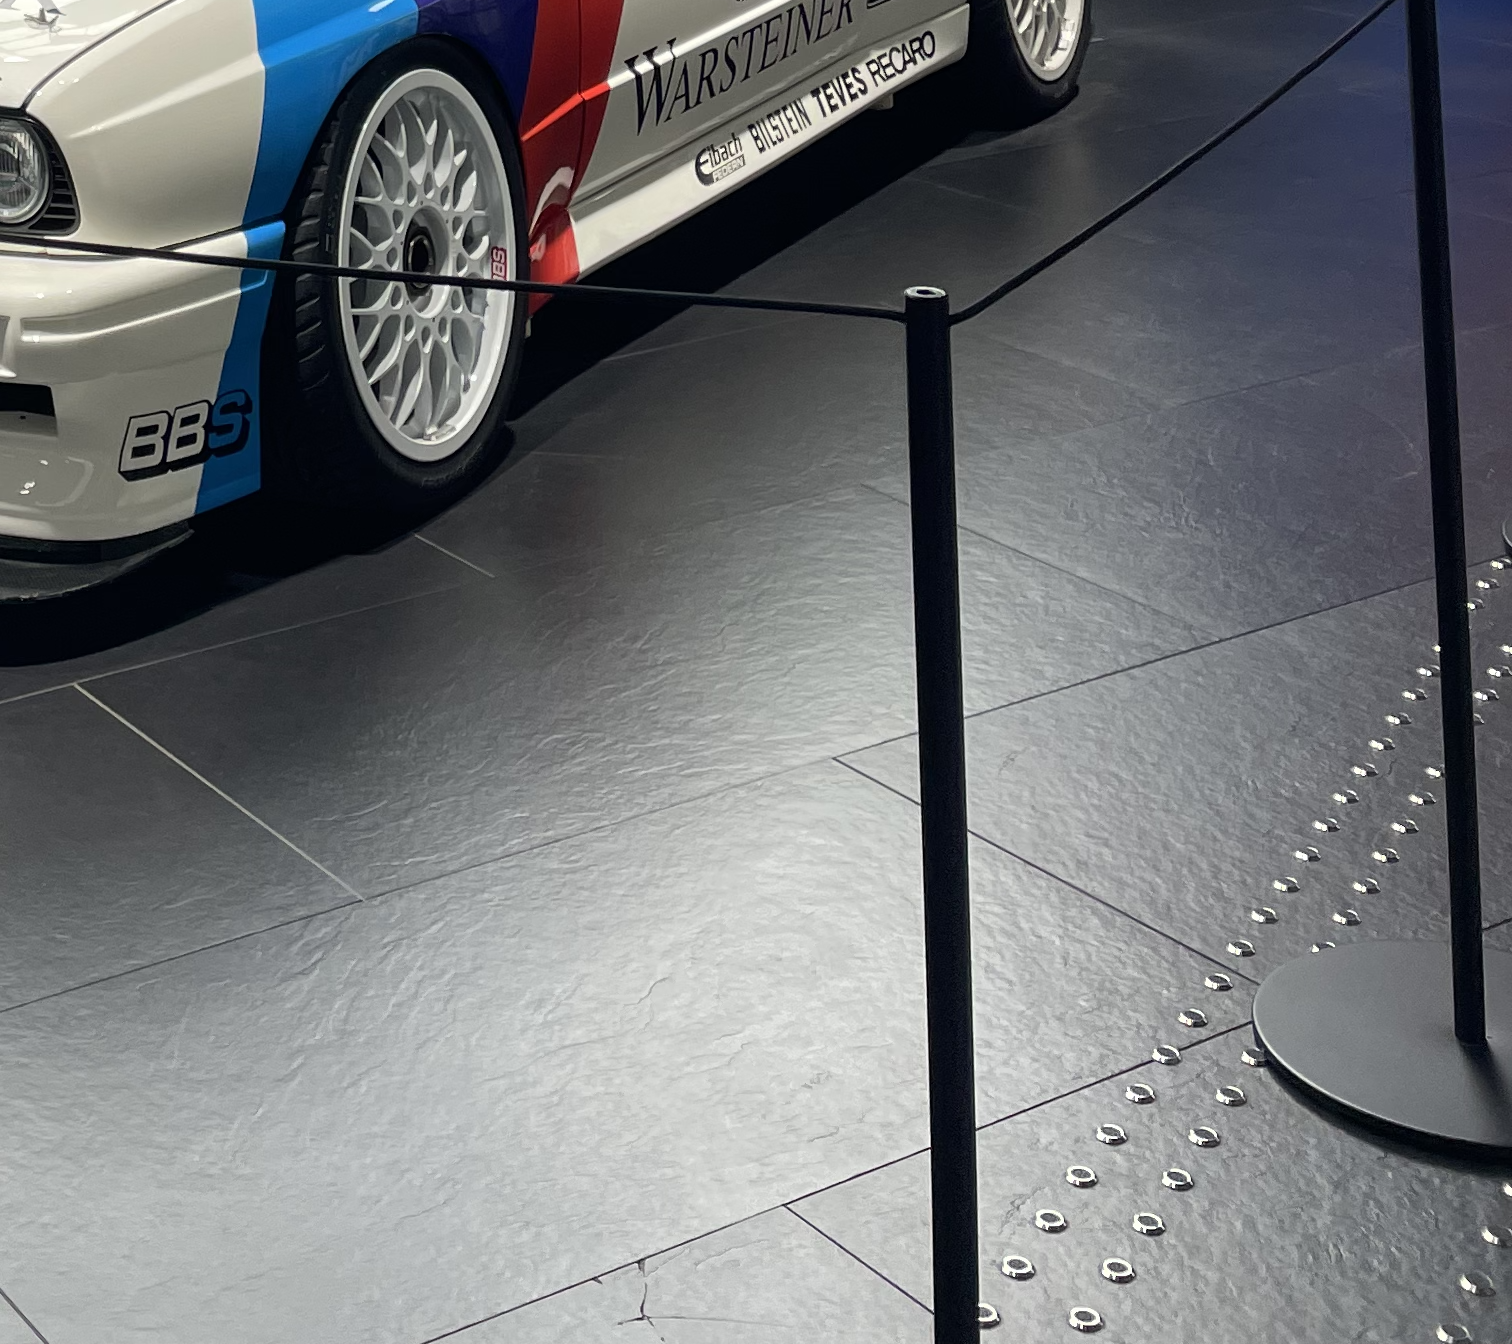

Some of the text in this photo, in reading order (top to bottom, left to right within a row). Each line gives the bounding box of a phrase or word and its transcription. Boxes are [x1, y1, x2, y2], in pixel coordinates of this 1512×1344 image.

[747, 30, 936, 154] BILSTEIN TEVES RECARO
[695, 132, 743, 186] Eibach
[118, 388, 253, 483] BBS
